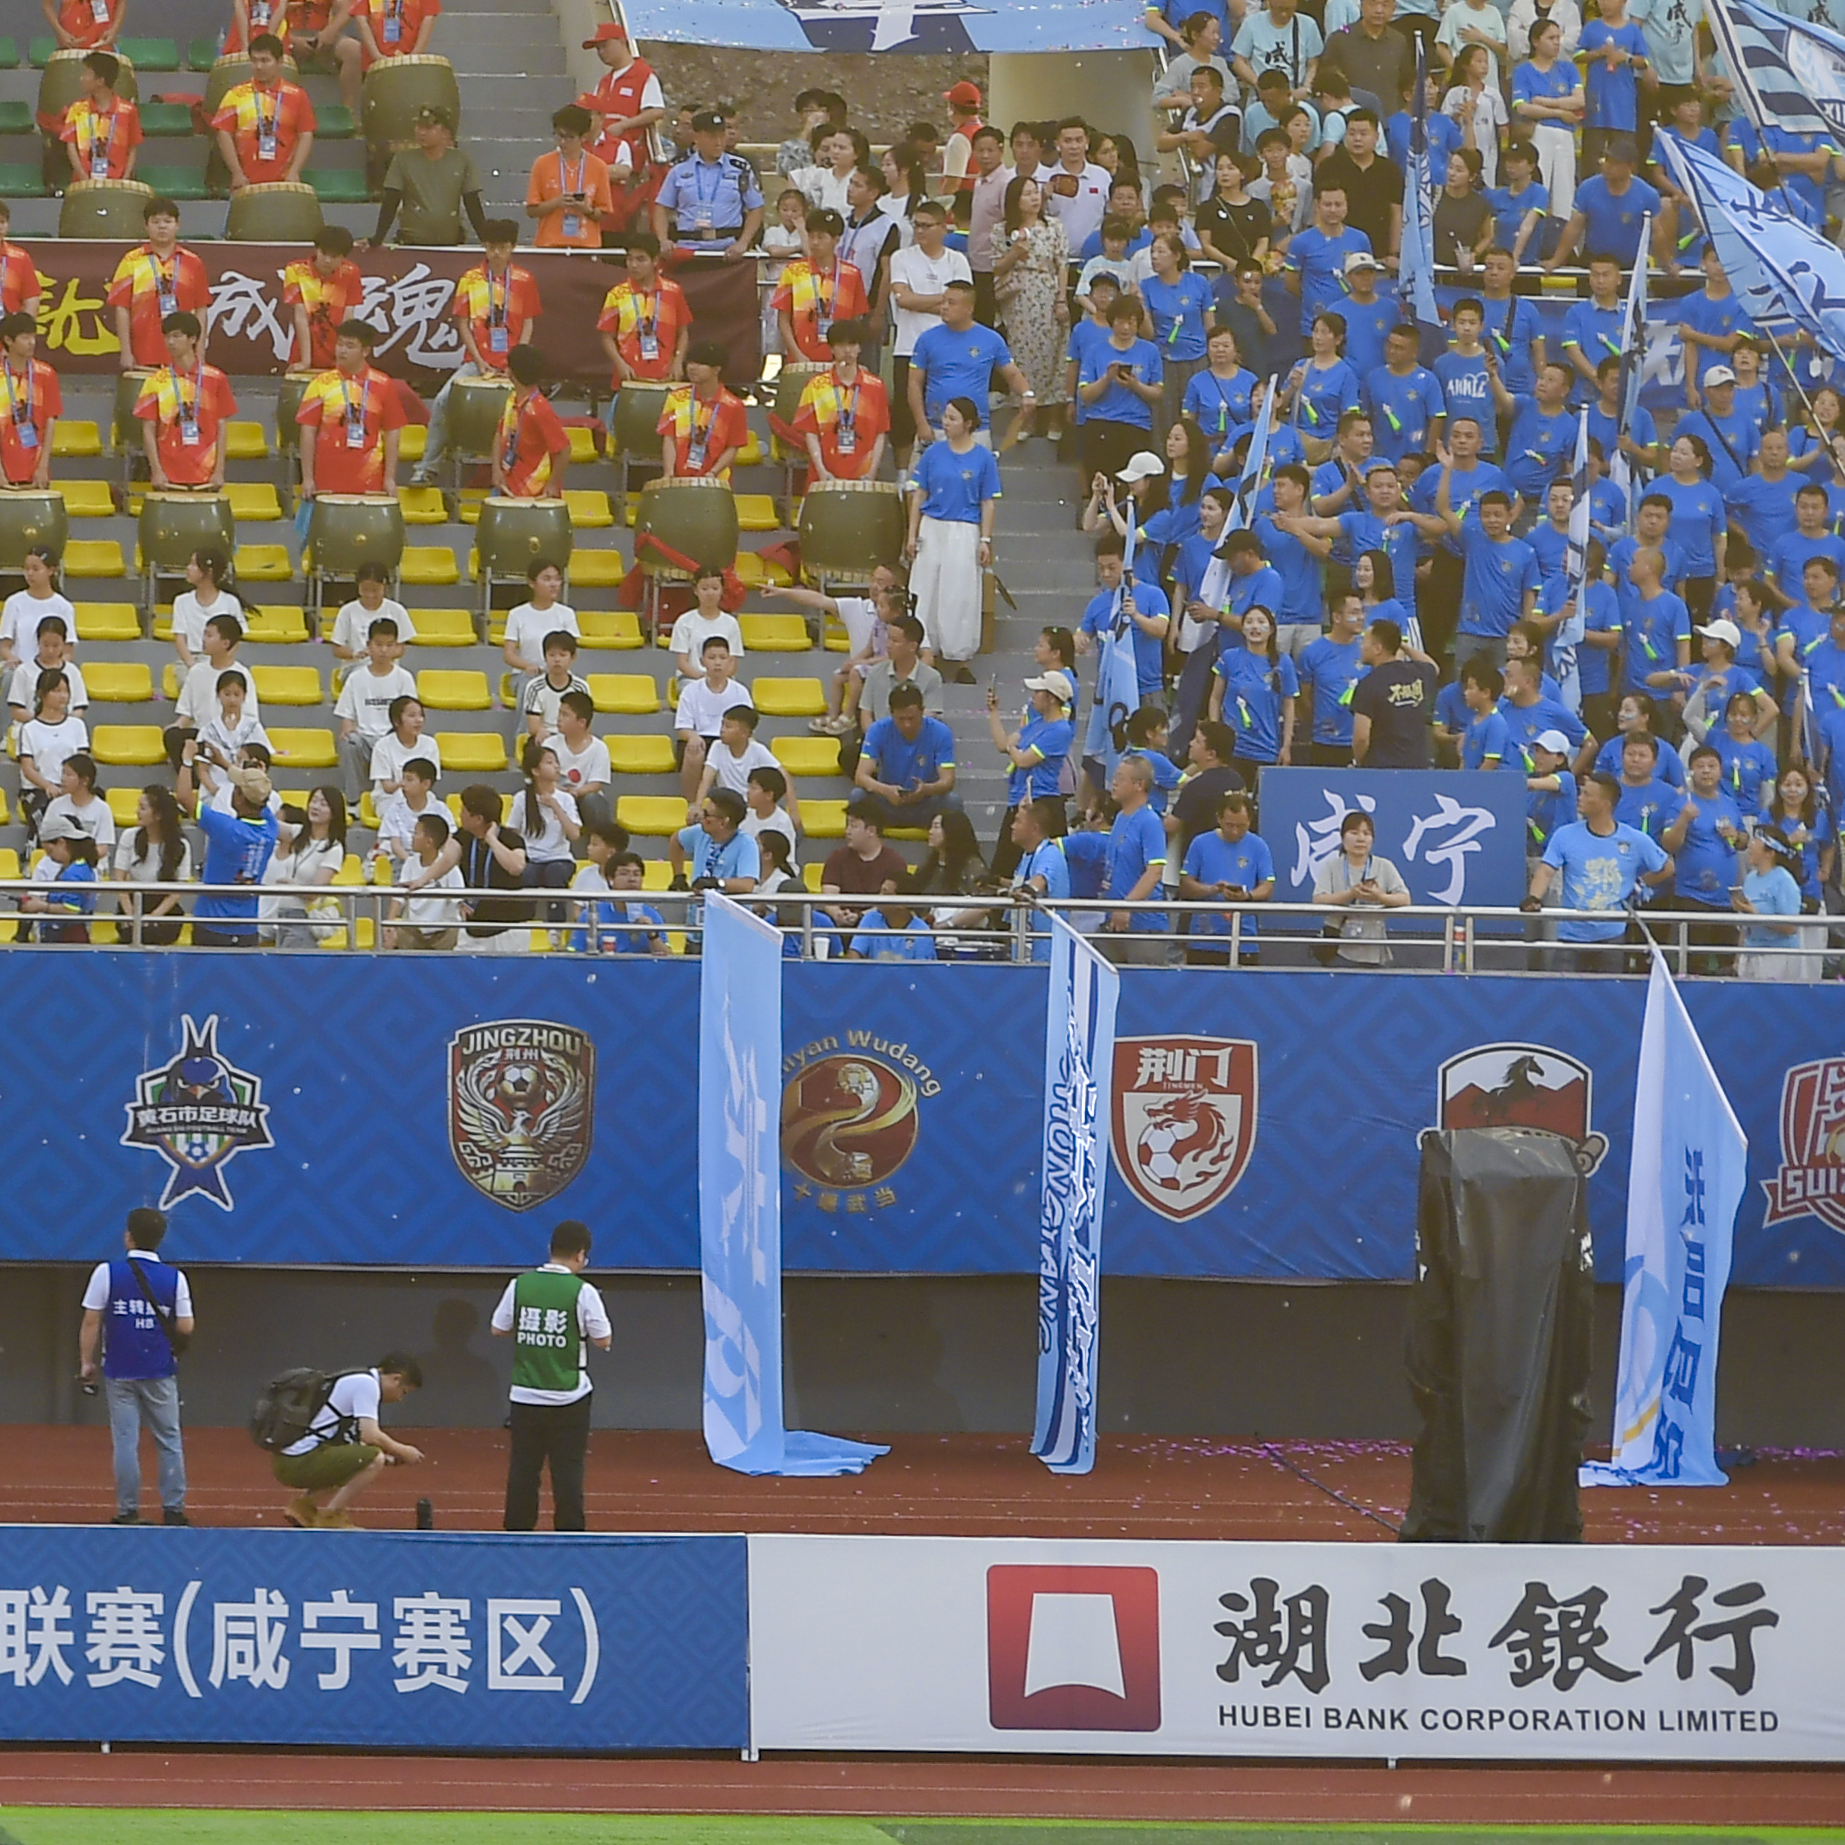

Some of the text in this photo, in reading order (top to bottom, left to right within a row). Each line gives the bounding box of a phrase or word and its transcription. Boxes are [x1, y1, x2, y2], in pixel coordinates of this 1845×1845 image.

[462, 1028, 581, 1055] JINGZHOU
[847, 1029, 942, 1098] Wudang
[1133, 1045, 1234, 1090] 荆门
[136, 1105, 258, 1129] 黄石市足球队
[517, 1307, 568, 1334] 摄影
[517, 1331, 568, 1349] PHOTO
[1213, 1575, 1780, 1695] 湖北銀行
[1218, 1704, 1780, 1733] HUBEI BANK CORPORATION LIMITED
